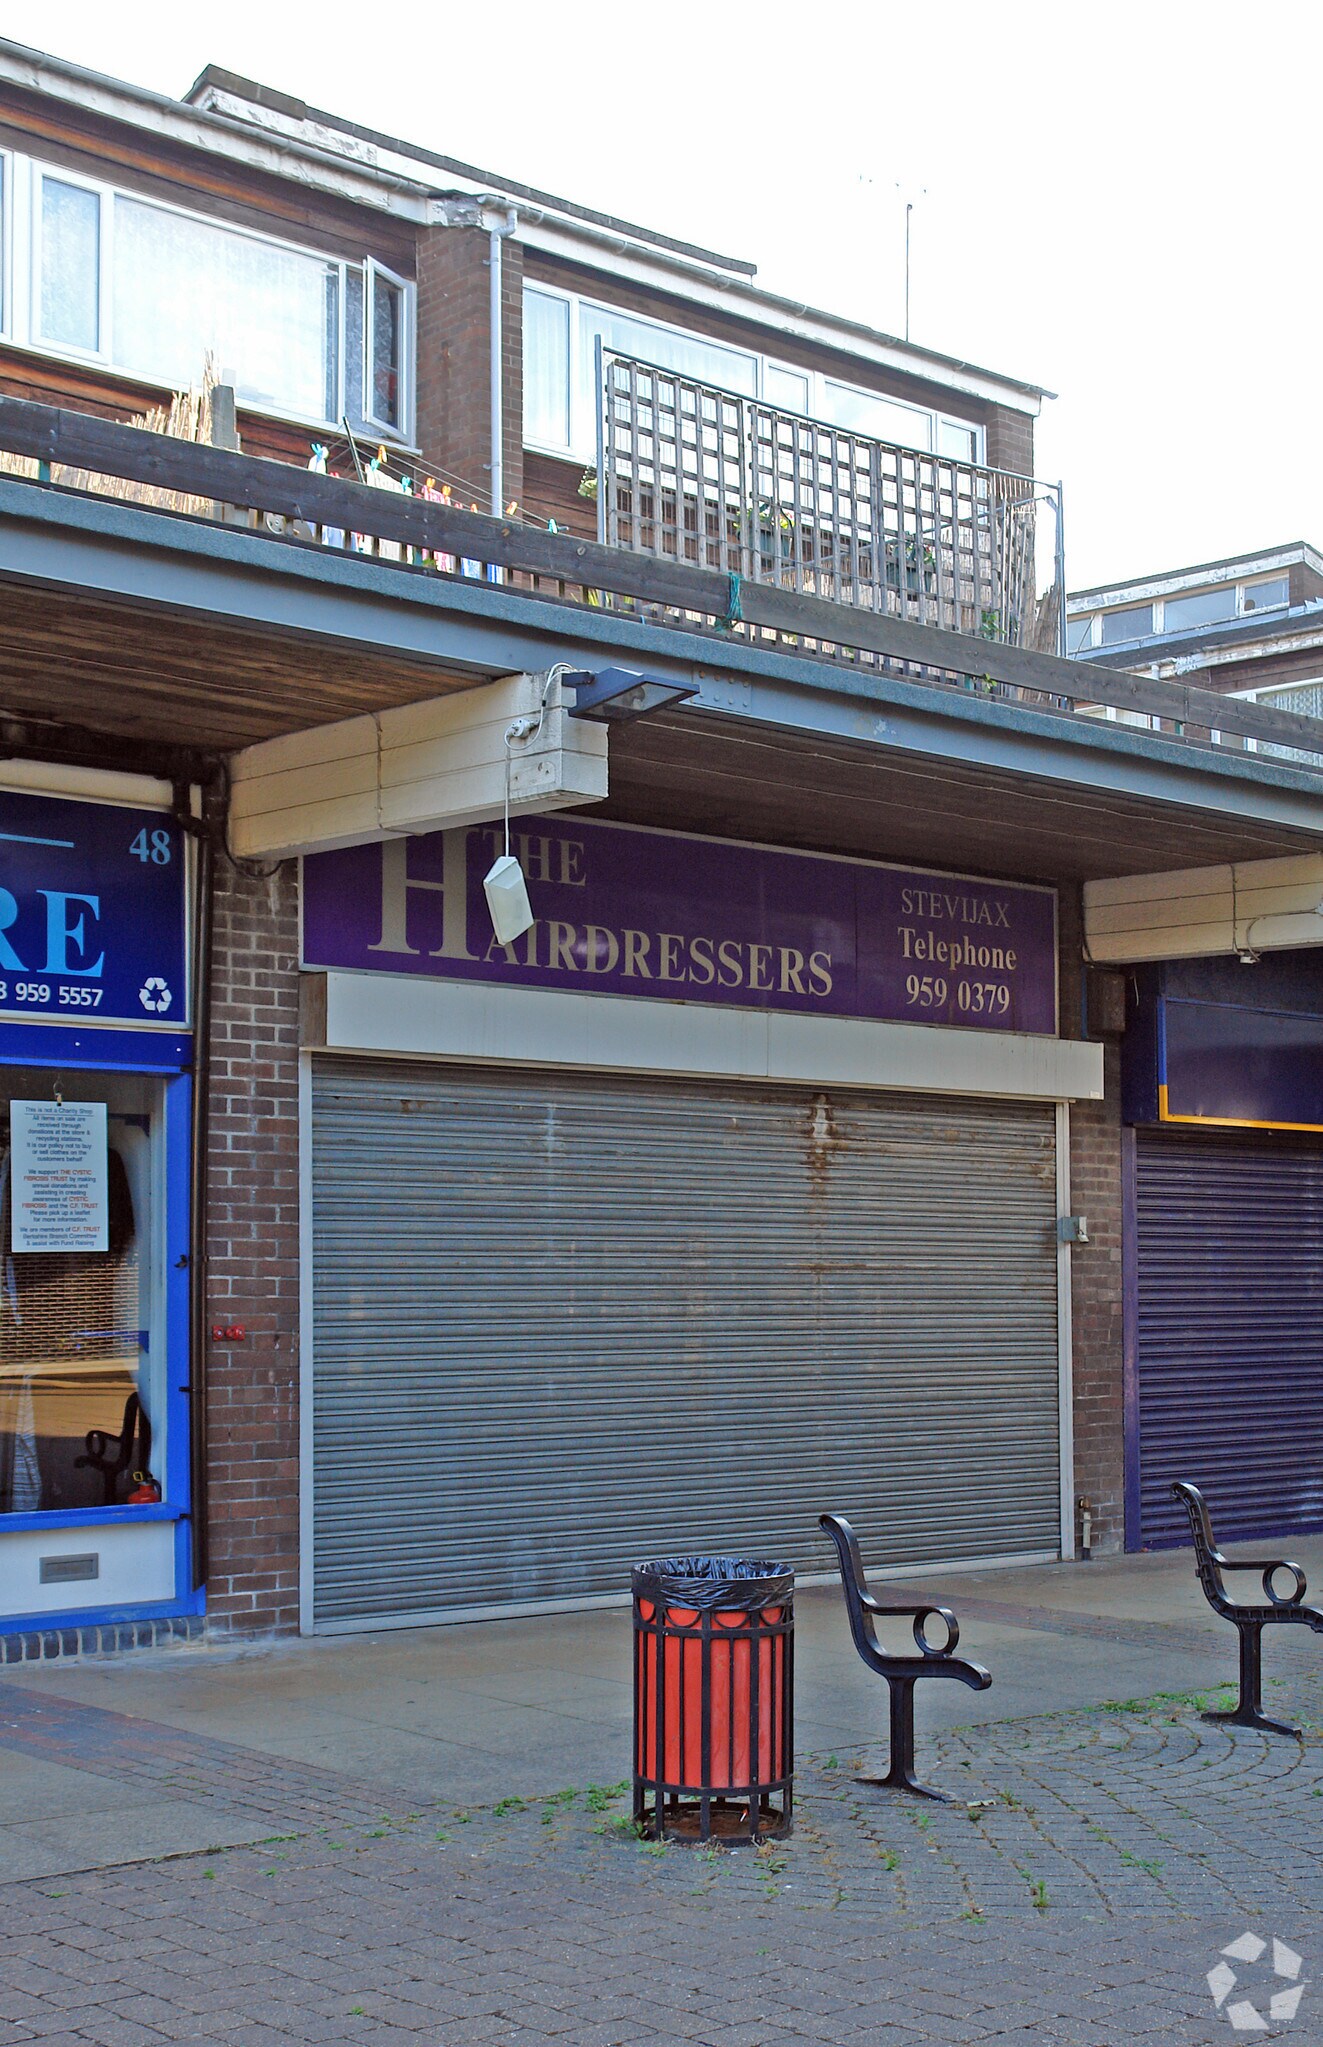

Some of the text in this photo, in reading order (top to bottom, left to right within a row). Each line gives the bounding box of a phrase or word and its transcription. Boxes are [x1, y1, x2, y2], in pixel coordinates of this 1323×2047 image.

[129, 828, 171, 865] 48
[483, 827, 587, 887] THE
[901, 888, 1011, 928] STEVIJAX
[897, 926, 1017, 971] Telephone
[15, 982, 51, 1003] 959
[58, 985, 103, 1007] 5557
[906, 974, 1010, 1014] 959 0379
